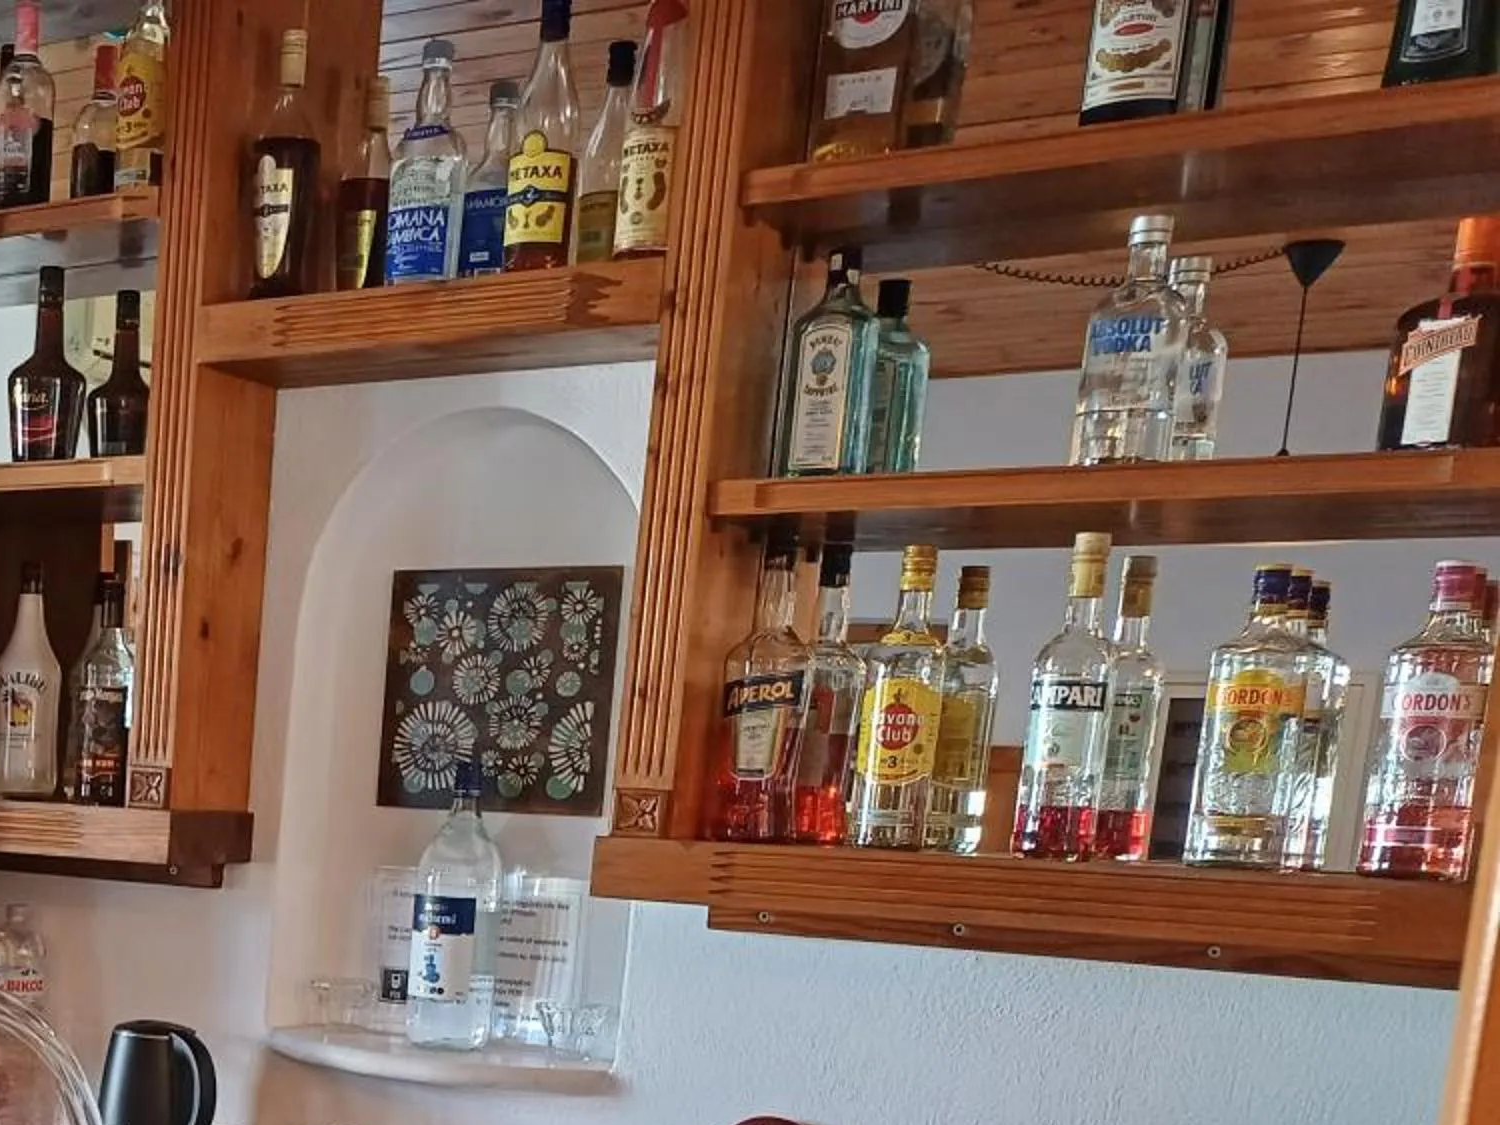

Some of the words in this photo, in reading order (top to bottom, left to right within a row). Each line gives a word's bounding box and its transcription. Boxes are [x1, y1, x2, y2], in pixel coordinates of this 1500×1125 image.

[260, 182, 289, 194] TAXA
[387, 209, 445, 231] OMANA
[727, 681, 795, 712] APEROL
[1030, 684, 1103, 706] AMPARI
[877, 712, 926, 726] avana
[876, 725, 912, 743] Club
